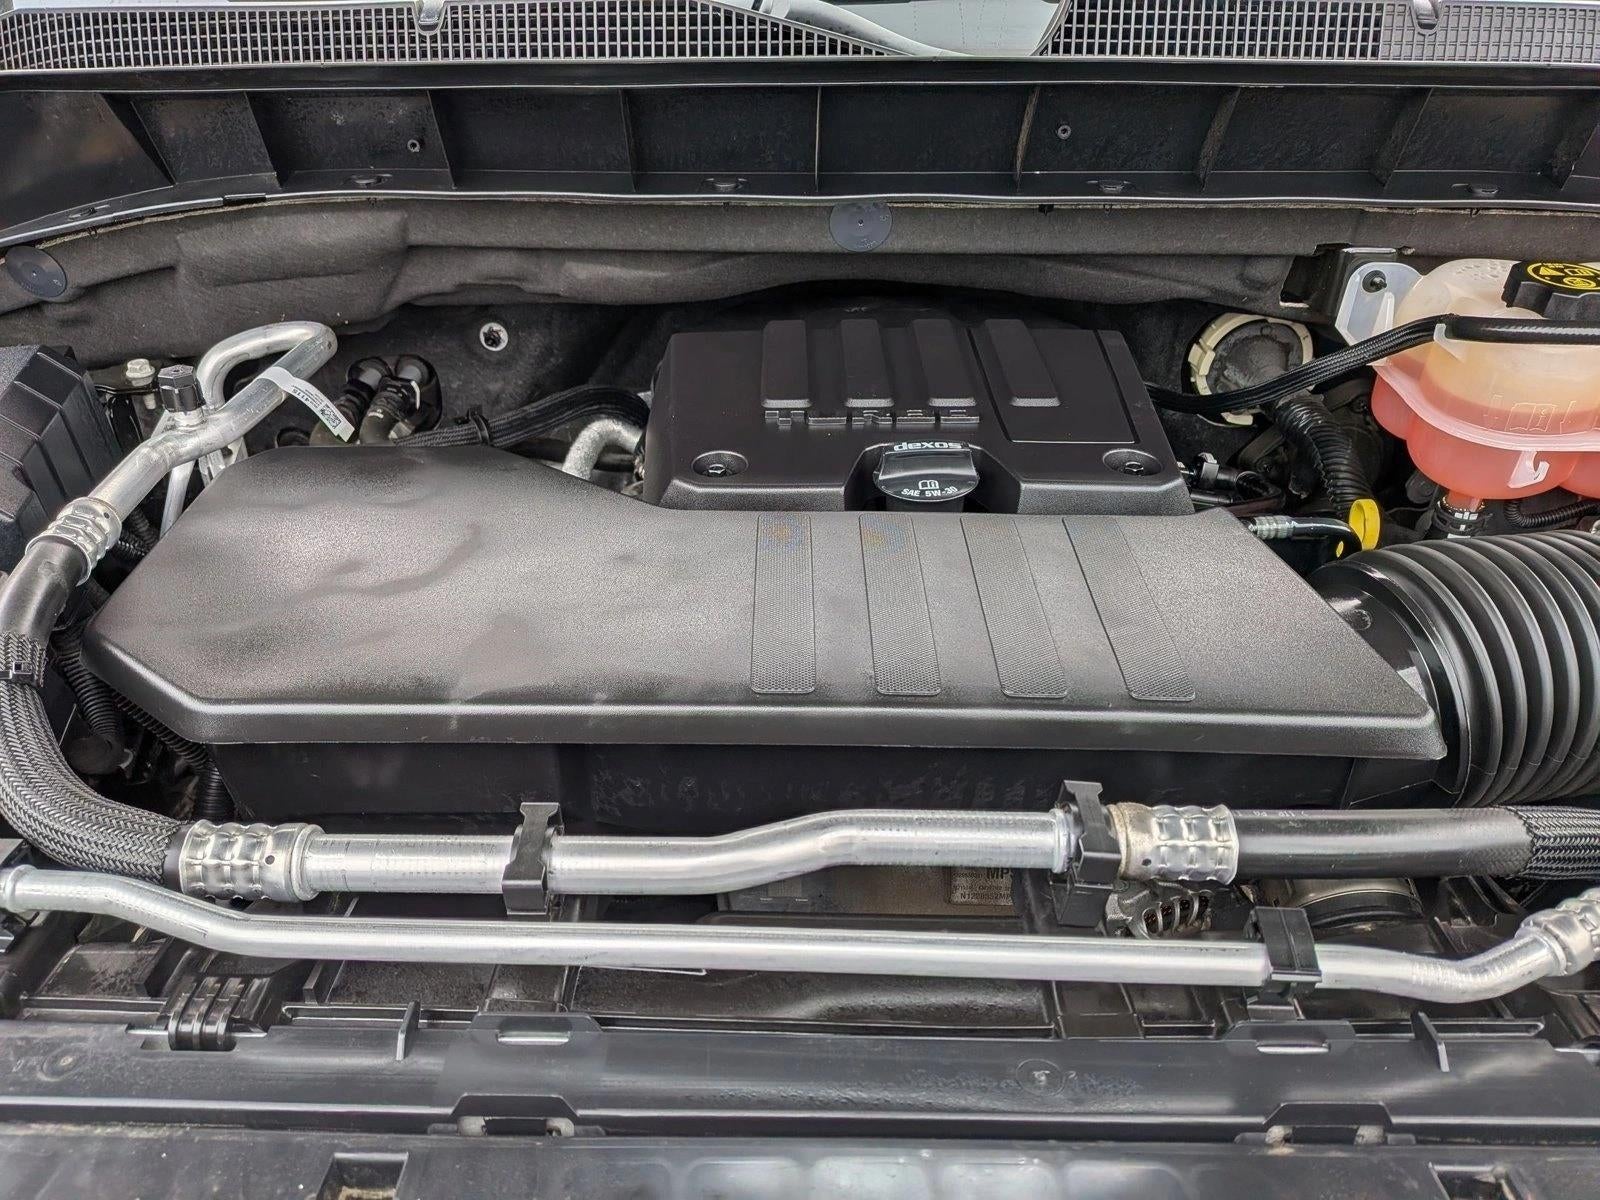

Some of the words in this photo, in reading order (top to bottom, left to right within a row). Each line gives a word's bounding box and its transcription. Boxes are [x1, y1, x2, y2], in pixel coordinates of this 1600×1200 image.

[893, 441, 962, 451] dexos
[901, 488, 920, 497] SAE
[925, 486, 958, 497] 5W-30
